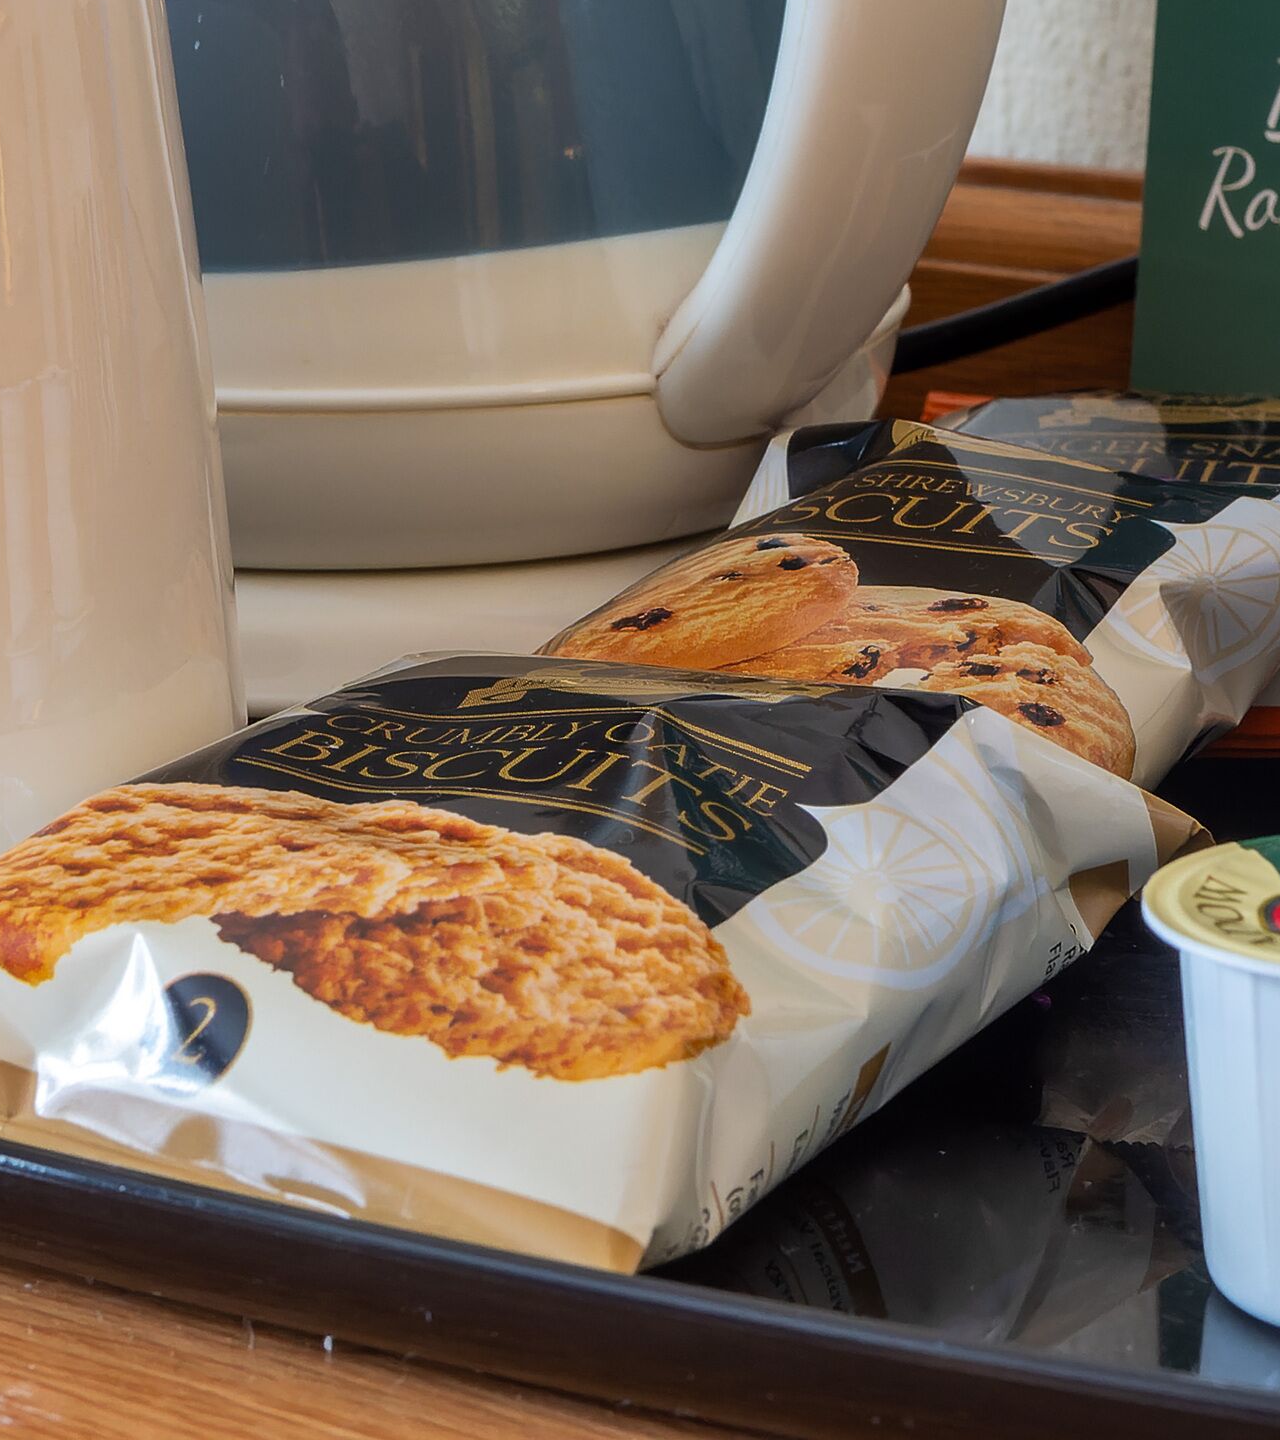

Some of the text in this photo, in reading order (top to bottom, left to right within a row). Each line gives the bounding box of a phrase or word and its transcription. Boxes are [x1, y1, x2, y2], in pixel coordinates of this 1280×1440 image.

[853, 473, 1137, 524] SHREWSBURY
[261, 728, 756, 844] BISCUITS
[325, 713, 790, 819] CRUMBLY OATIE
[176, 996, 218, 1066] 2
